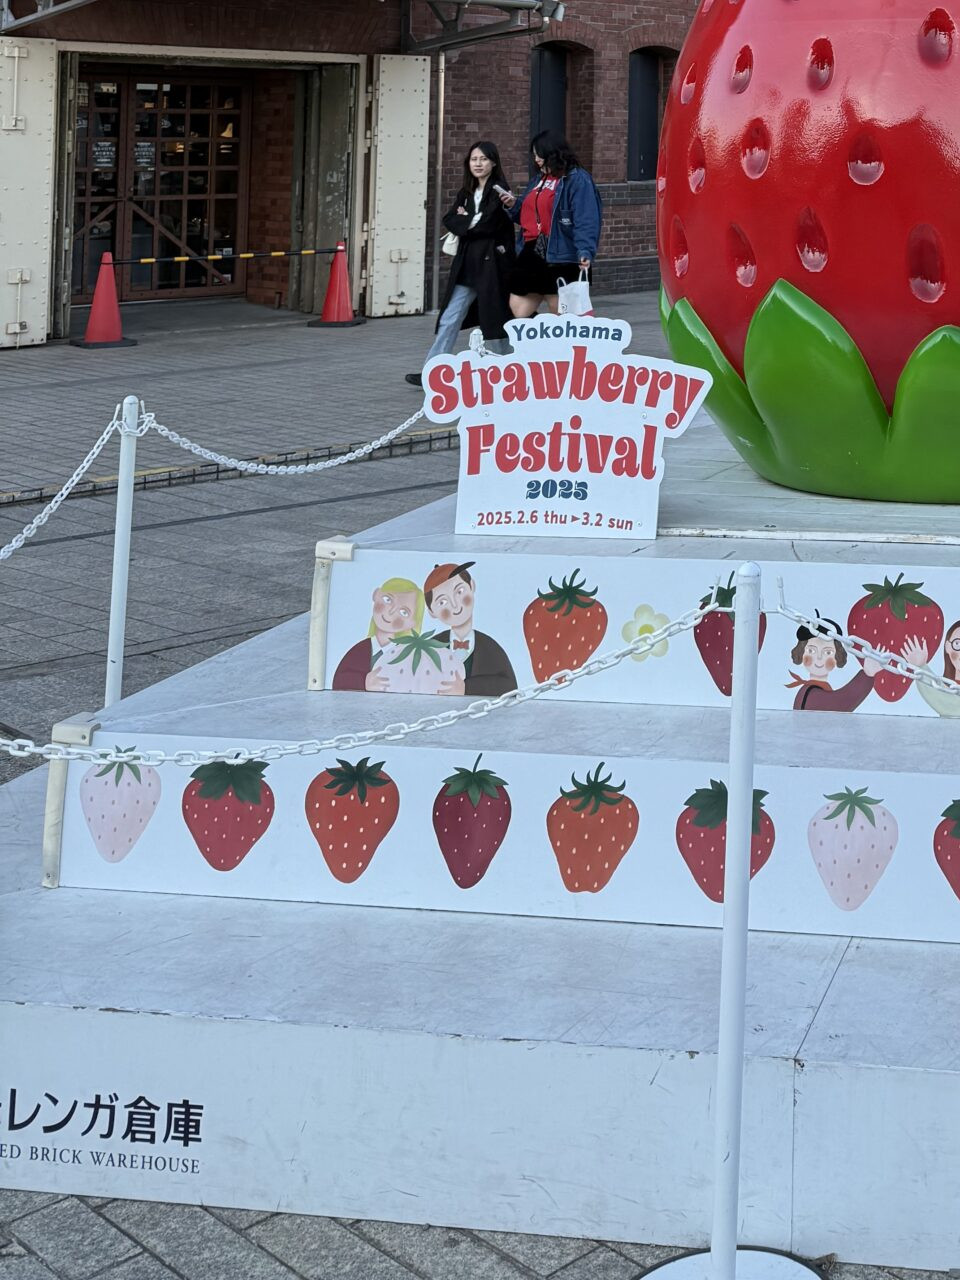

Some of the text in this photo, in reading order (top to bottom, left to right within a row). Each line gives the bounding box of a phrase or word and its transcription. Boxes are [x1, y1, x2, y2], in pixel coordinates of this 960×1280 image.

[512, 321, 623, 342] Yokohama
[428, 345, 704, 429] Strawberry
[466, 415, 658, 480] Festival
[525, 479, 589, 501] 2025
[476, 510, 539, 527] 2025.2.6
[543, 510, 567, 525] thu
[607, 516, 633, 530] sun
[0, 1088, 204, 1148] レンガ倉庫
[0, 1144, 200, 1174] ED BRICK WAREHOUSE
